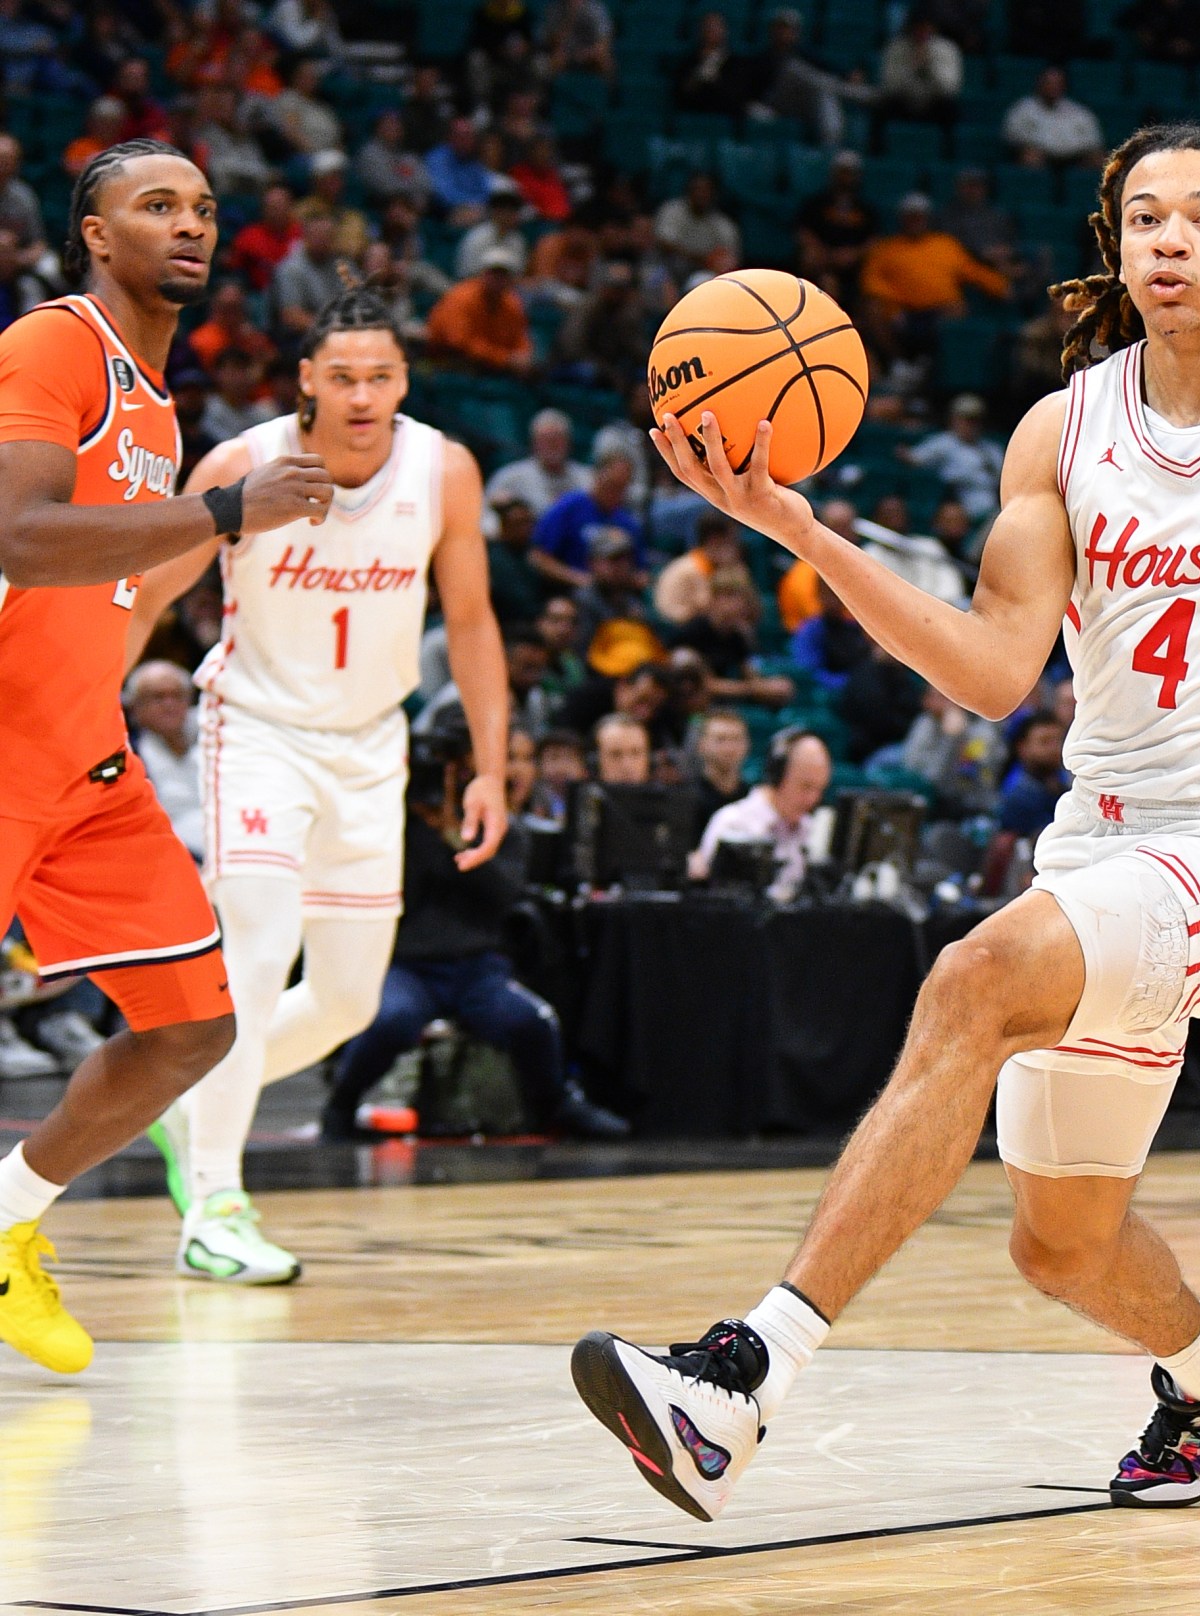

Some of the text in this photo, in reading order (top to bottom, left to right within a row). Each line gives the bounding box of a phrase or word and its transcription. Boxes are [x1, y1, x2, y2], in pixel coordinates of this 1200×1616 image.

[648, 356, 707, 407] lson
[269, 544, 416, 592] Houston
[332, 606, 350, 670] 1
[1132, 597, 1196, 709] 4
